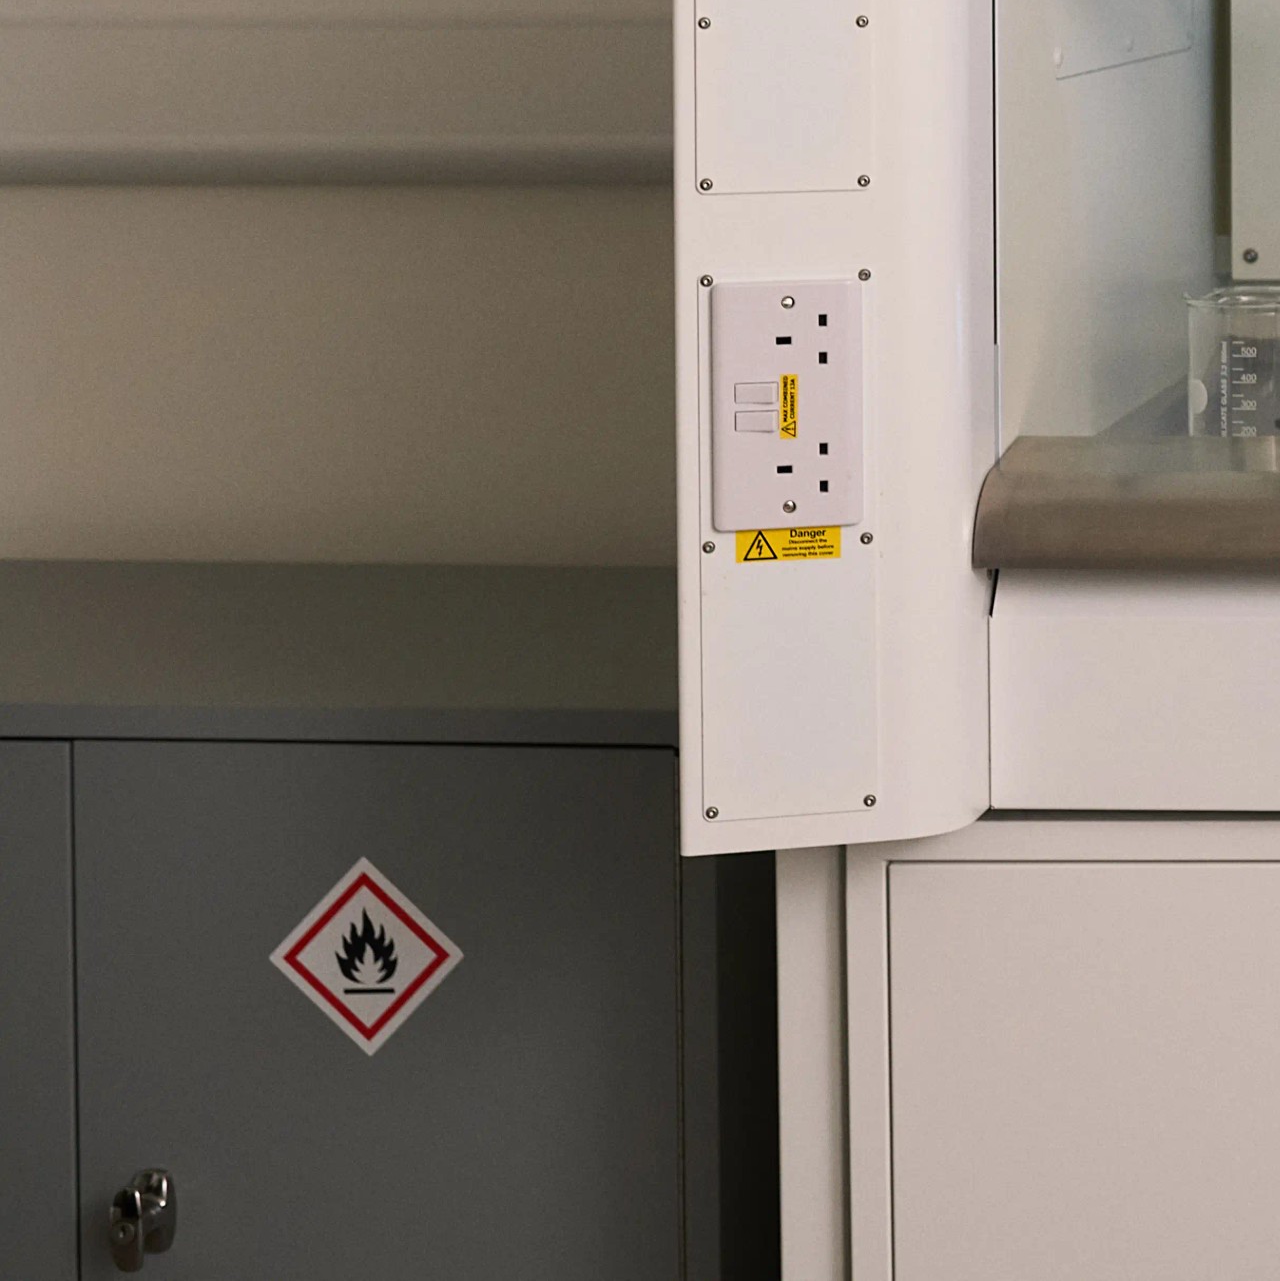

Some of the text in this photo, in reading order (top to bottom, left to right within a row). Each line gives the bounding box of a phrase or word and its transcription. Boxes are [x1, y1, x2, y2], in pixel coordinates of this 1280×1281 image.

[1241, 347, 1256, 355] 500
[1240, 374, 1256, 382] 400
[1241, 400, 1256, 408] 300
[790, 529, 826, 539] Danger
